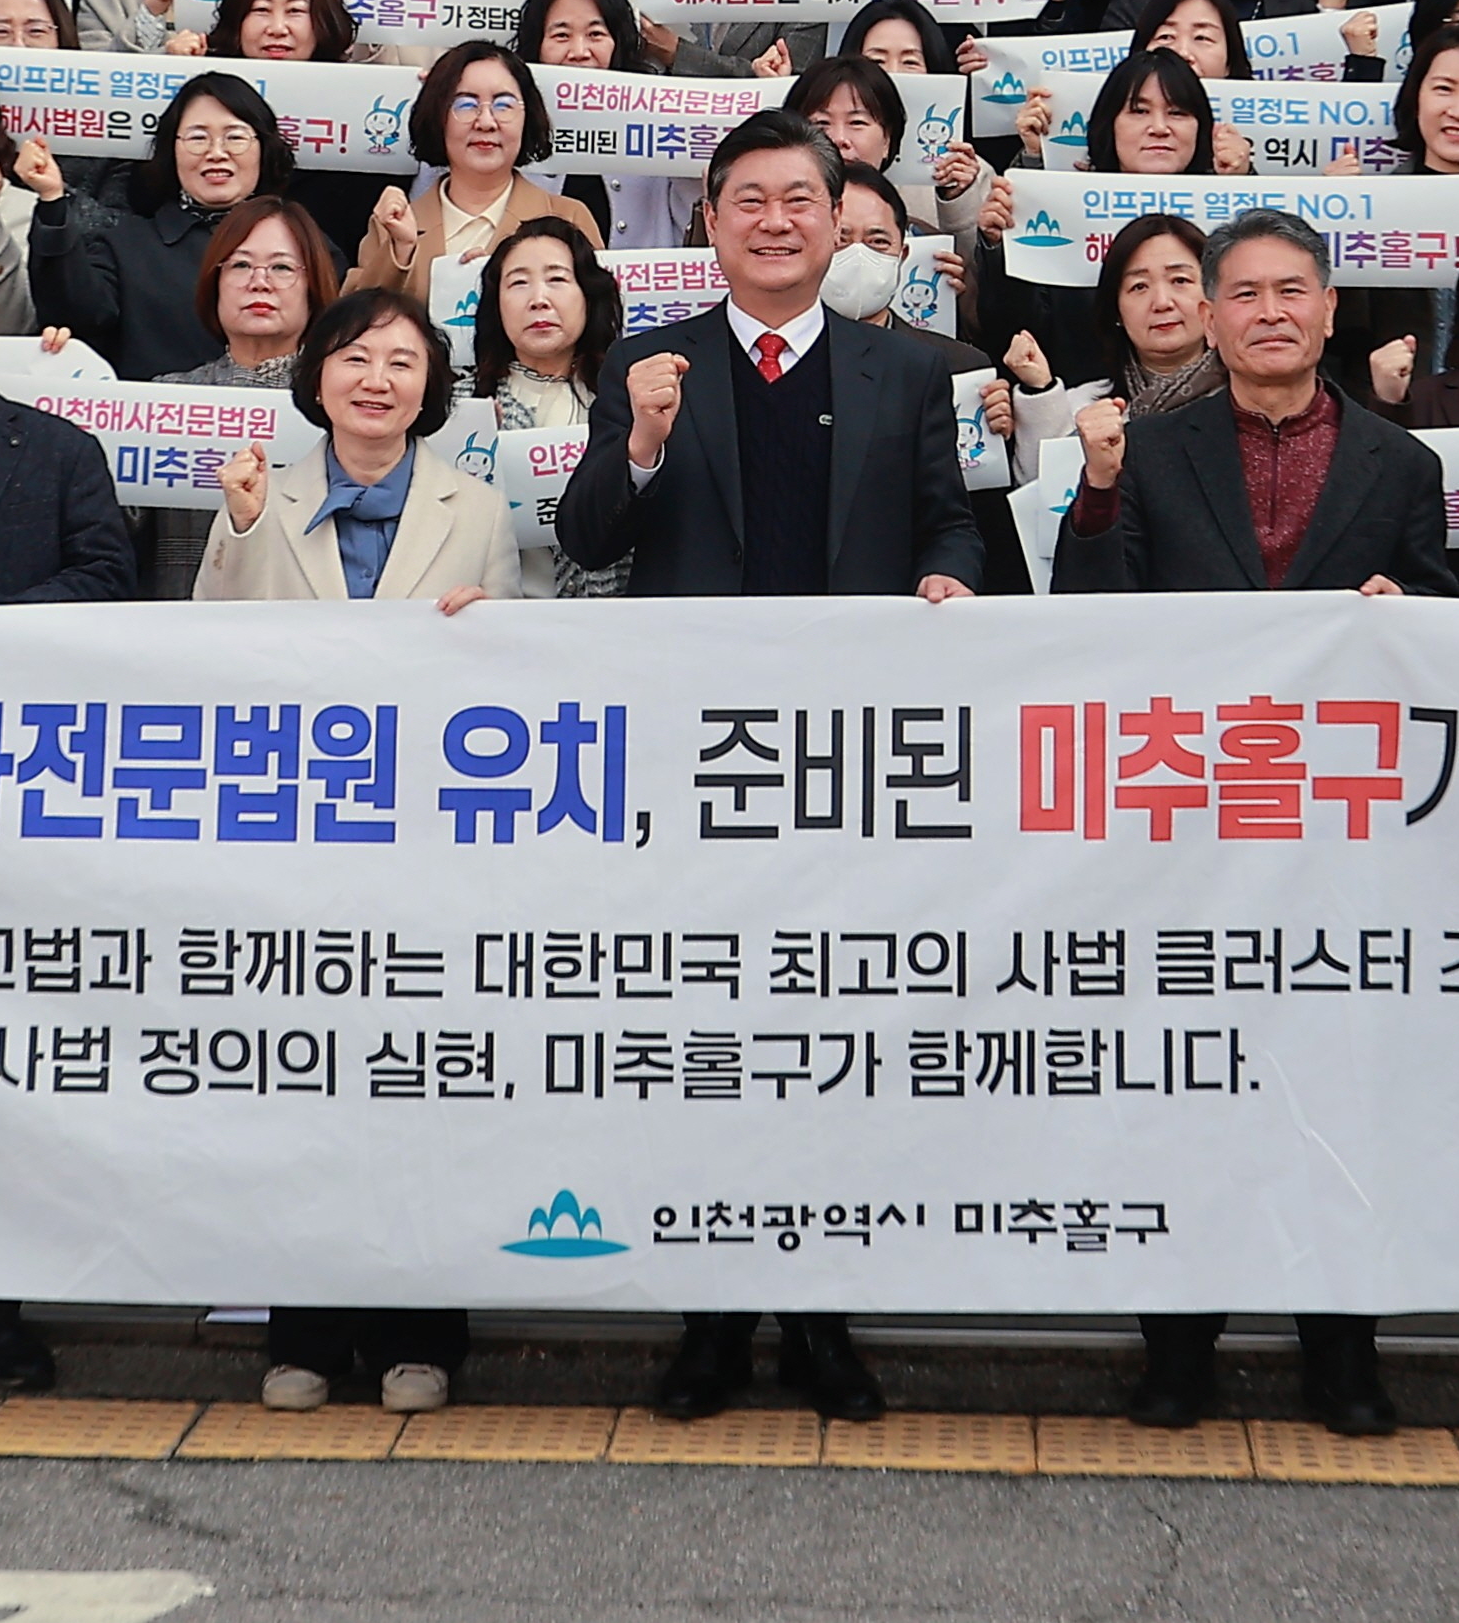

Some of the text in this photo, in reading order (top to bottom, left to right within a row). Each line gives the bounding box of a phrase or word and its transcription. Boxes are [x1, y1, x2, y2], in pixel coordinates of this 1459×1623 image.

[556, 81, 761, 114] 인천해사전문법원
[1231, 98, 1310, 126] 열정도
[1319, 99, 1394, 125] NO.1
[0, 105, 134, 141] 해사법원은
[555, 126, 618, 155] 준비된
[1263, 138, 1318, 167] 역시
[1084, 190, 1194, 219] 인프라도
[1296, 192, 1373, 220] NO.1
[33, 396, 276, 441] 인천해사전문법원
[438, 701, 652, 850] 유치,
[692, 704, 974, 840] 준비된
[177, 927, 446, 999] 함께하는
[473, 930, 742, 1000] 대한민국
[769, 930, 970, 999] 최고의
[995, 928, 1128, 998] 사법
[1154, 927, 1414, 996] 클러스터
[140, 1028, 339, 1097] 정의의
[365, 1030, 517, 1100] 실현,
[544, 1030, 882, 1100] 미추홀구가
[908, 1027, 1262, 1098] 함께합니다.
[652, 1198, 1171, 1254] 인천광역시 미추홀구
